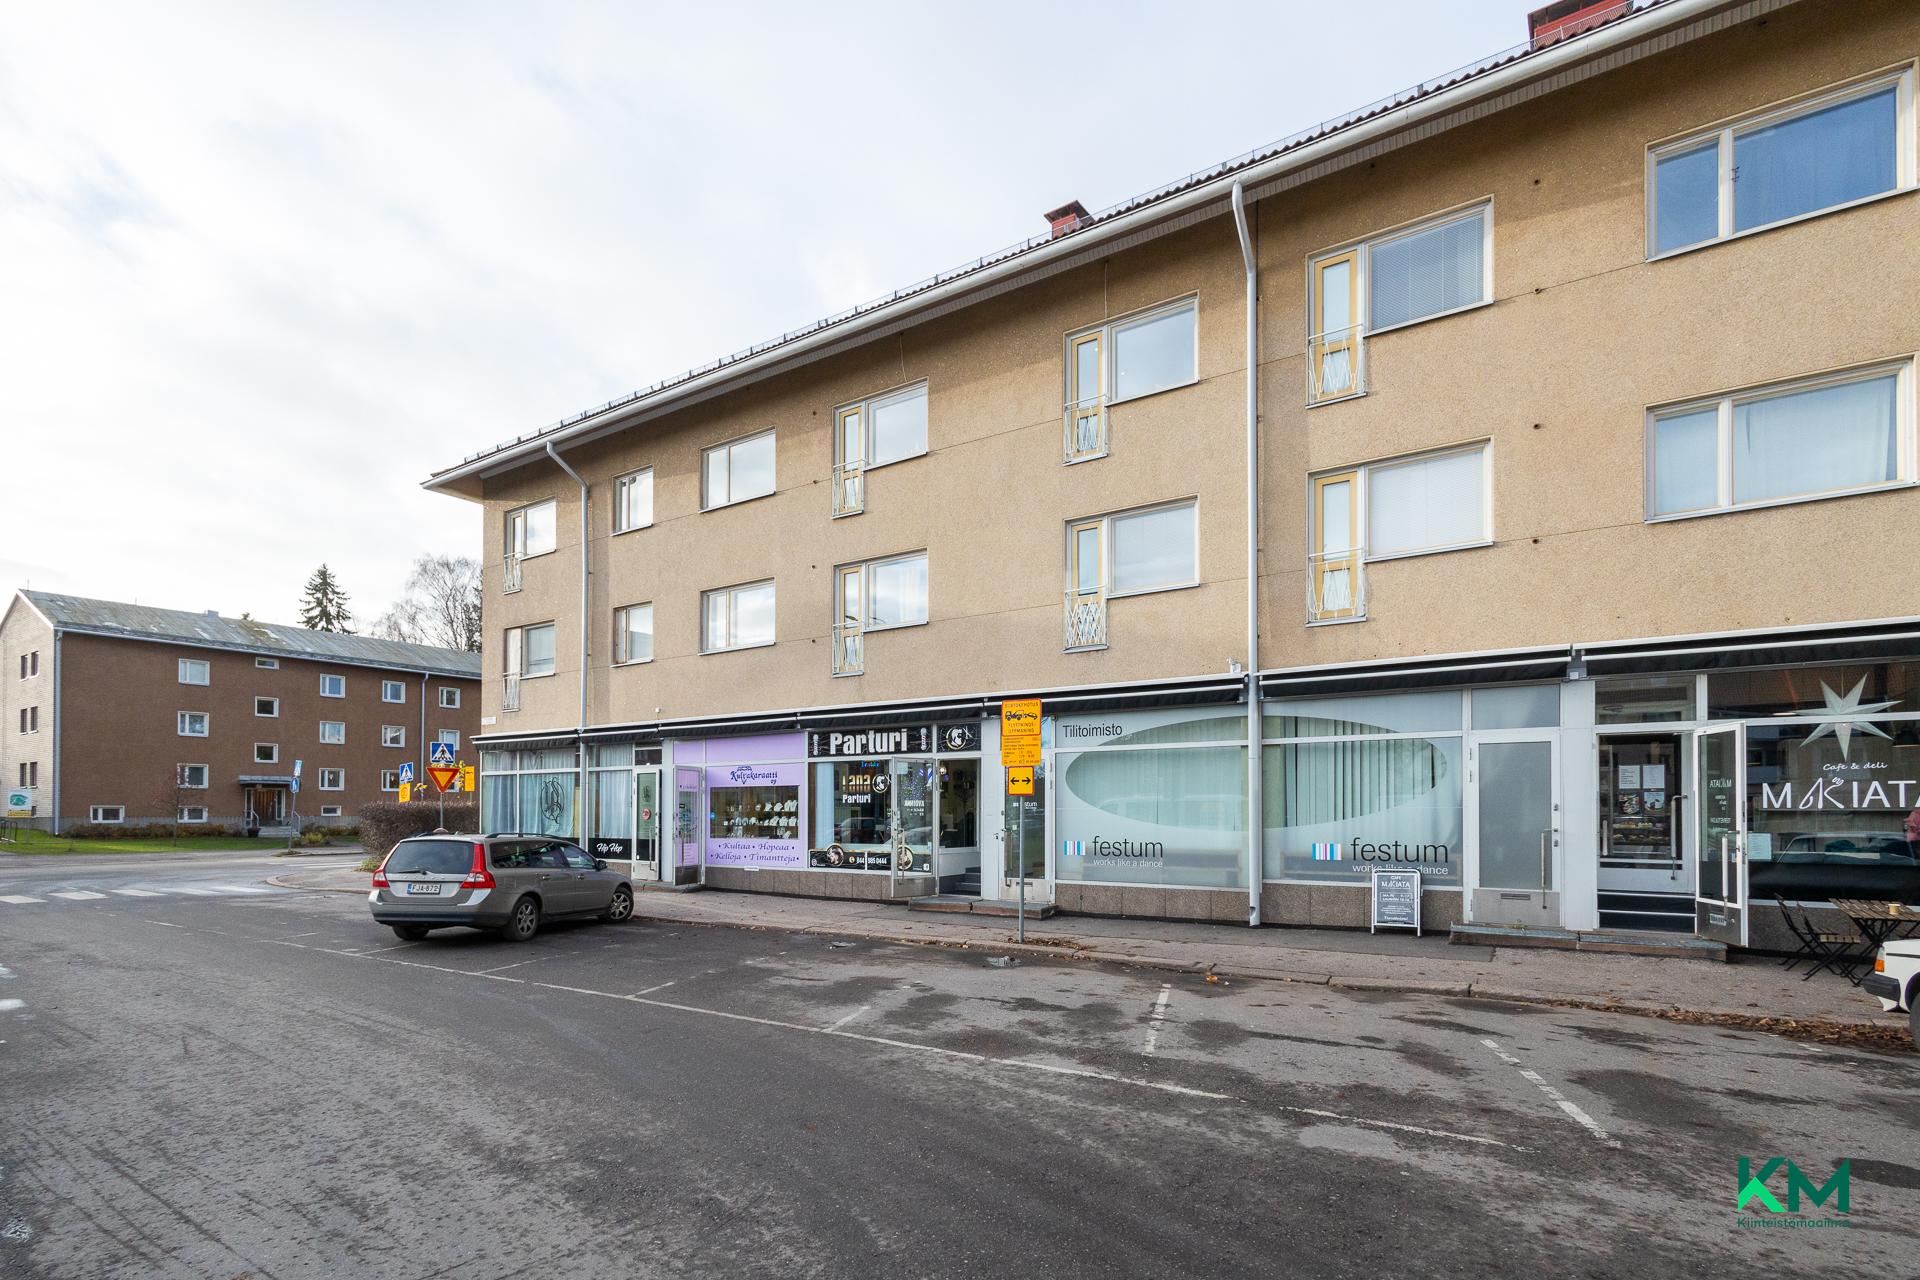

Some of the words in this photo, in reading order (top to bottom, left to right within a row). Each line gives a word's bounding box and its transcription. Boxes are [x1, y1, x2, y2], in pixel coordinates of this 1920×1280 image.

[1062, 723, 1123, 738] Tilitoimisto
[829, 728, 908, 755] Parturi
[842, 793, 871, 804] Parturi
[1762, 777, 1920, 809] MAKIAT
[596, 843, 609, 854] Hip
[608, 843, 623, 854] Hop
[722, 842, 751, 850] Kultaa
[759, 842, 789, 851] Hopeaa
[1092, 835, 1163, 858] festum
[1350, 837, 1448, 863] festum
[714, 853, 741, 863] Kelloja
[749, 853, 796, 864] Timantteja
[1093, 859, 1115, 867] works
[1117, 859, 1131, 867] like
[1140, 859, 1163, 868] dance
